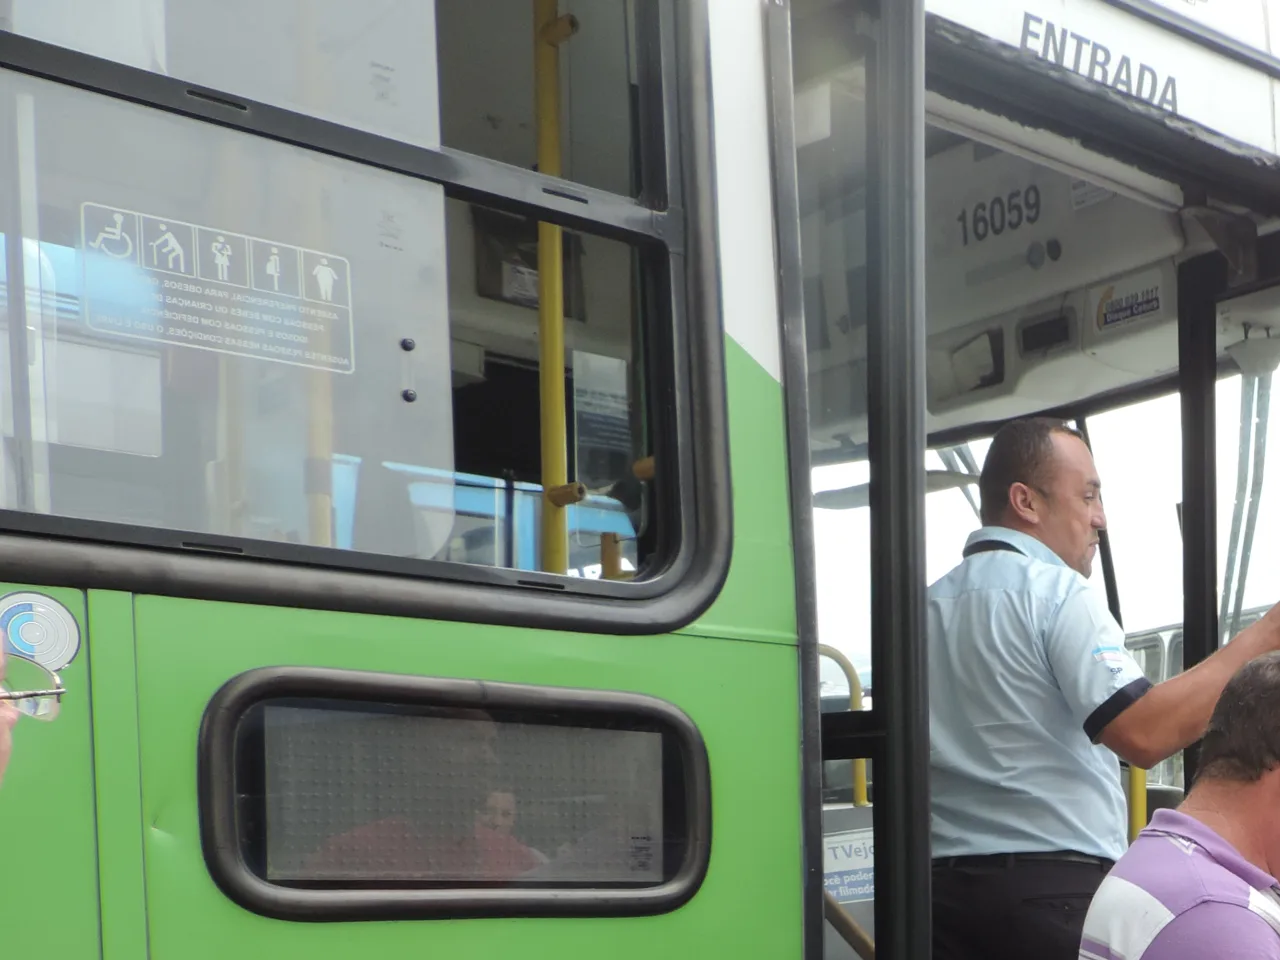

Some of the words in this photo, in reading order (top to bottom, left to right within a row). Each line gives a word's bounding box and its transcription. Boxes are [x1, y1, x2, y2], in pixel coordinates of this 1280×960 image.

[1019, 11, 1179, 114] ENTRADA
[956, 184, 1042, 247] 16059
[844, 870, 874, 885] poder
